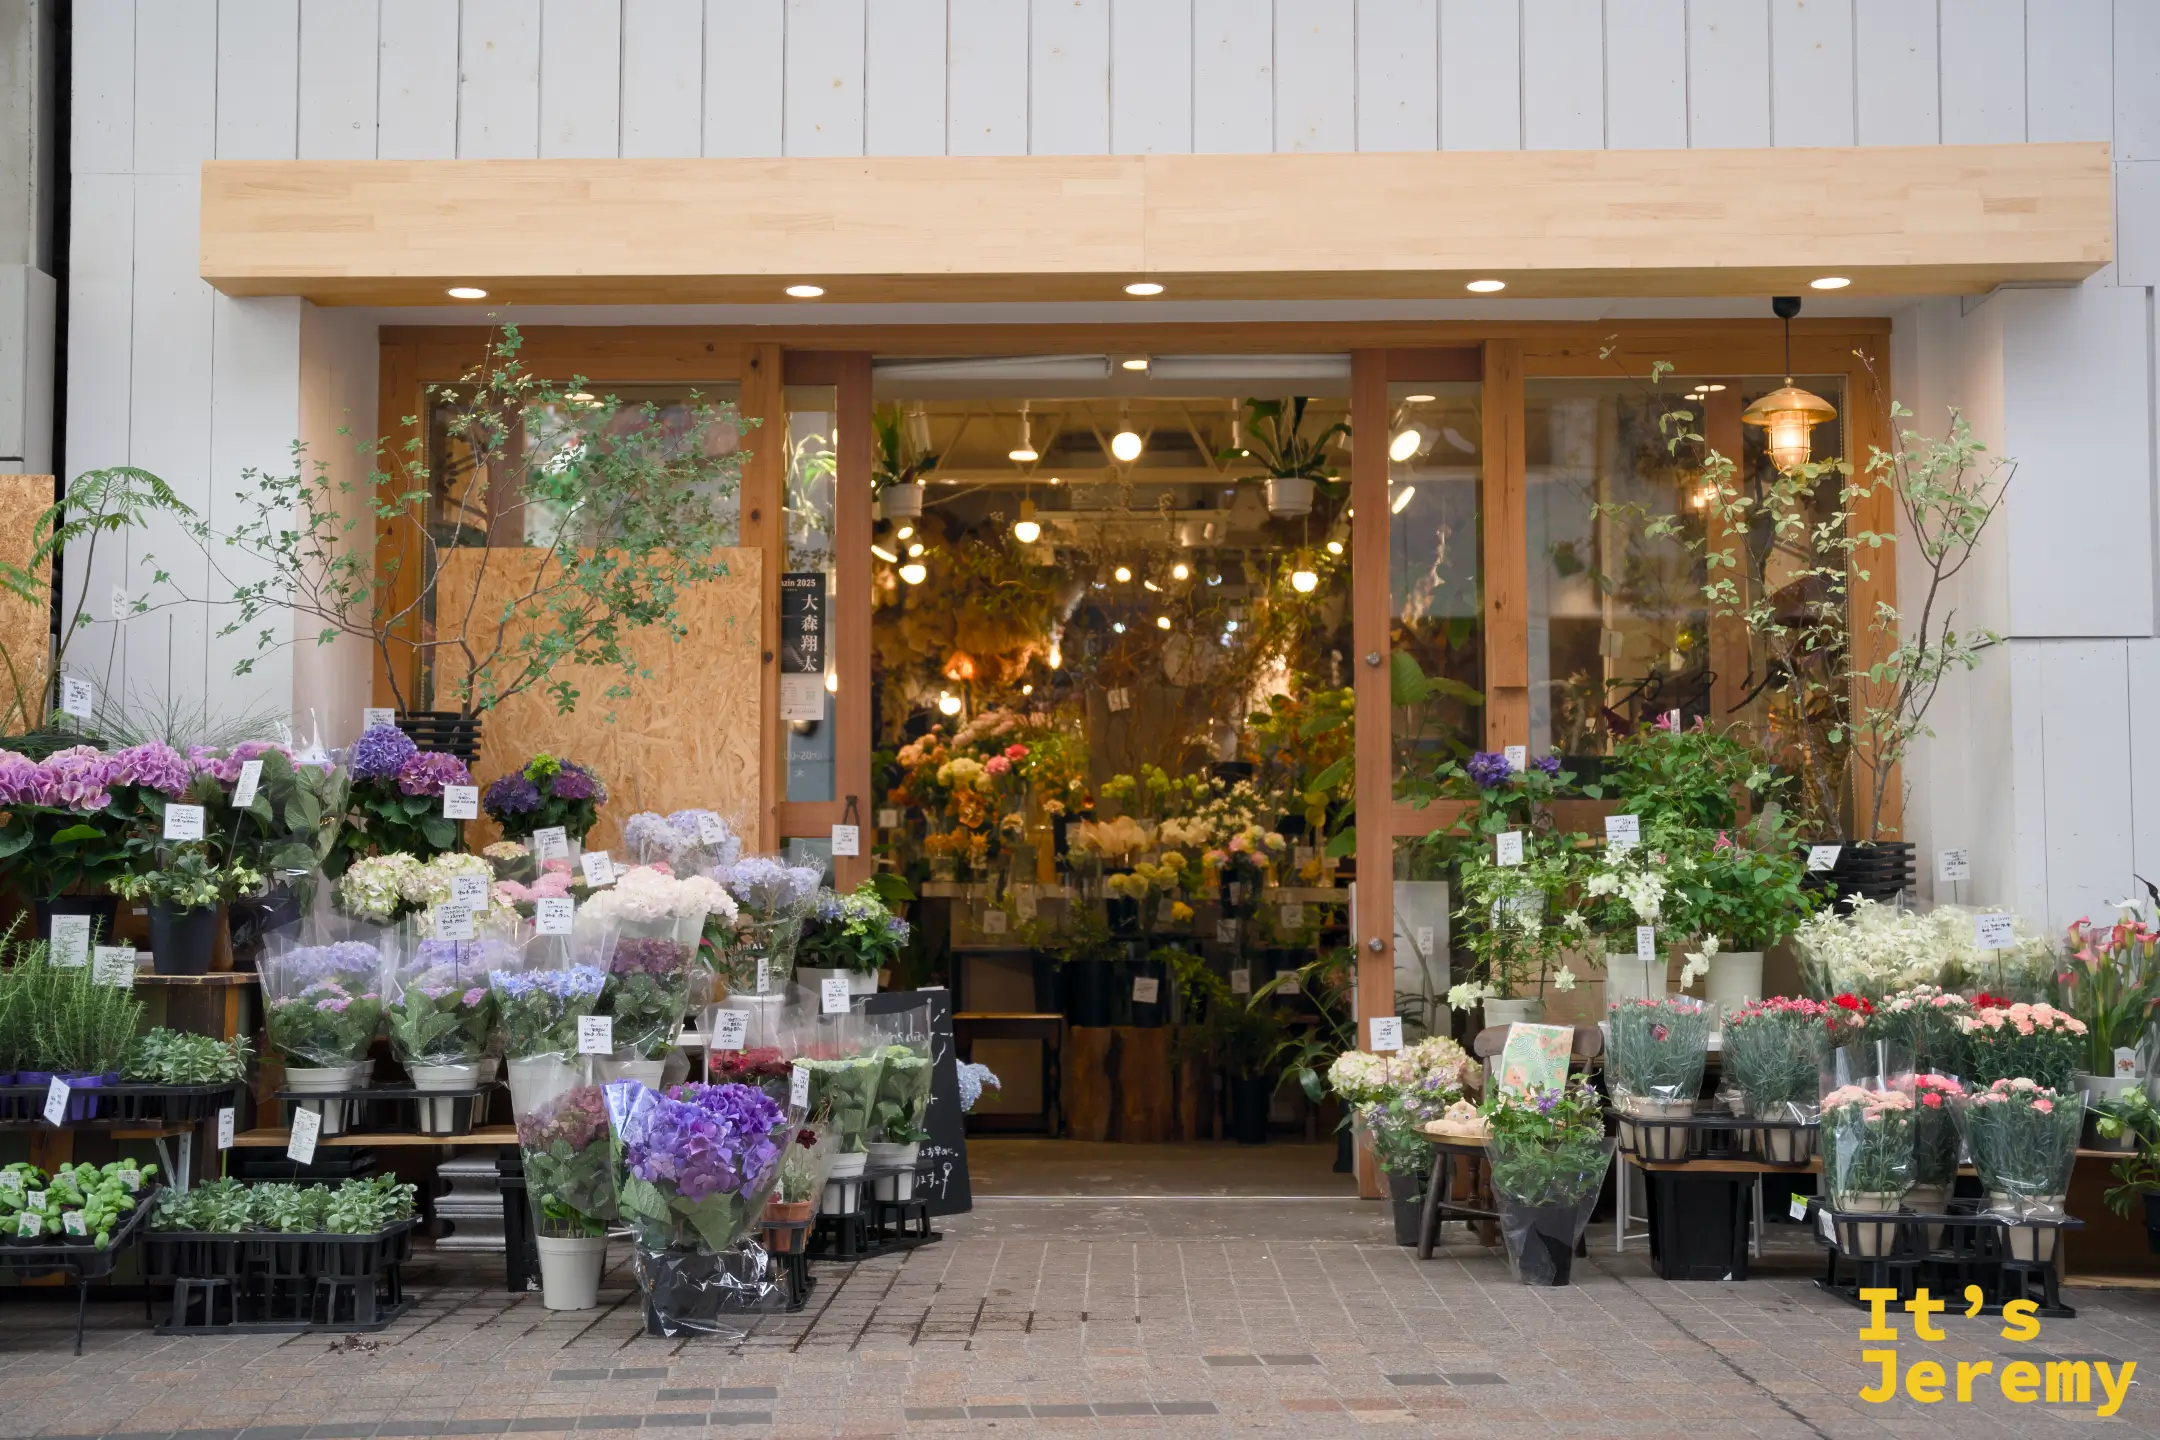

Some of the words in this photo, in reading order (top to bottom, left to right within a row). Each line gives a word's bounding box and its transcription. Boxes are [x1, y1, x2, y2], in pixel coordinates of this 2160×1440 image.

[796, 578, 816, 587] 2025
[801, 593, 819, 672] 大森翔太
